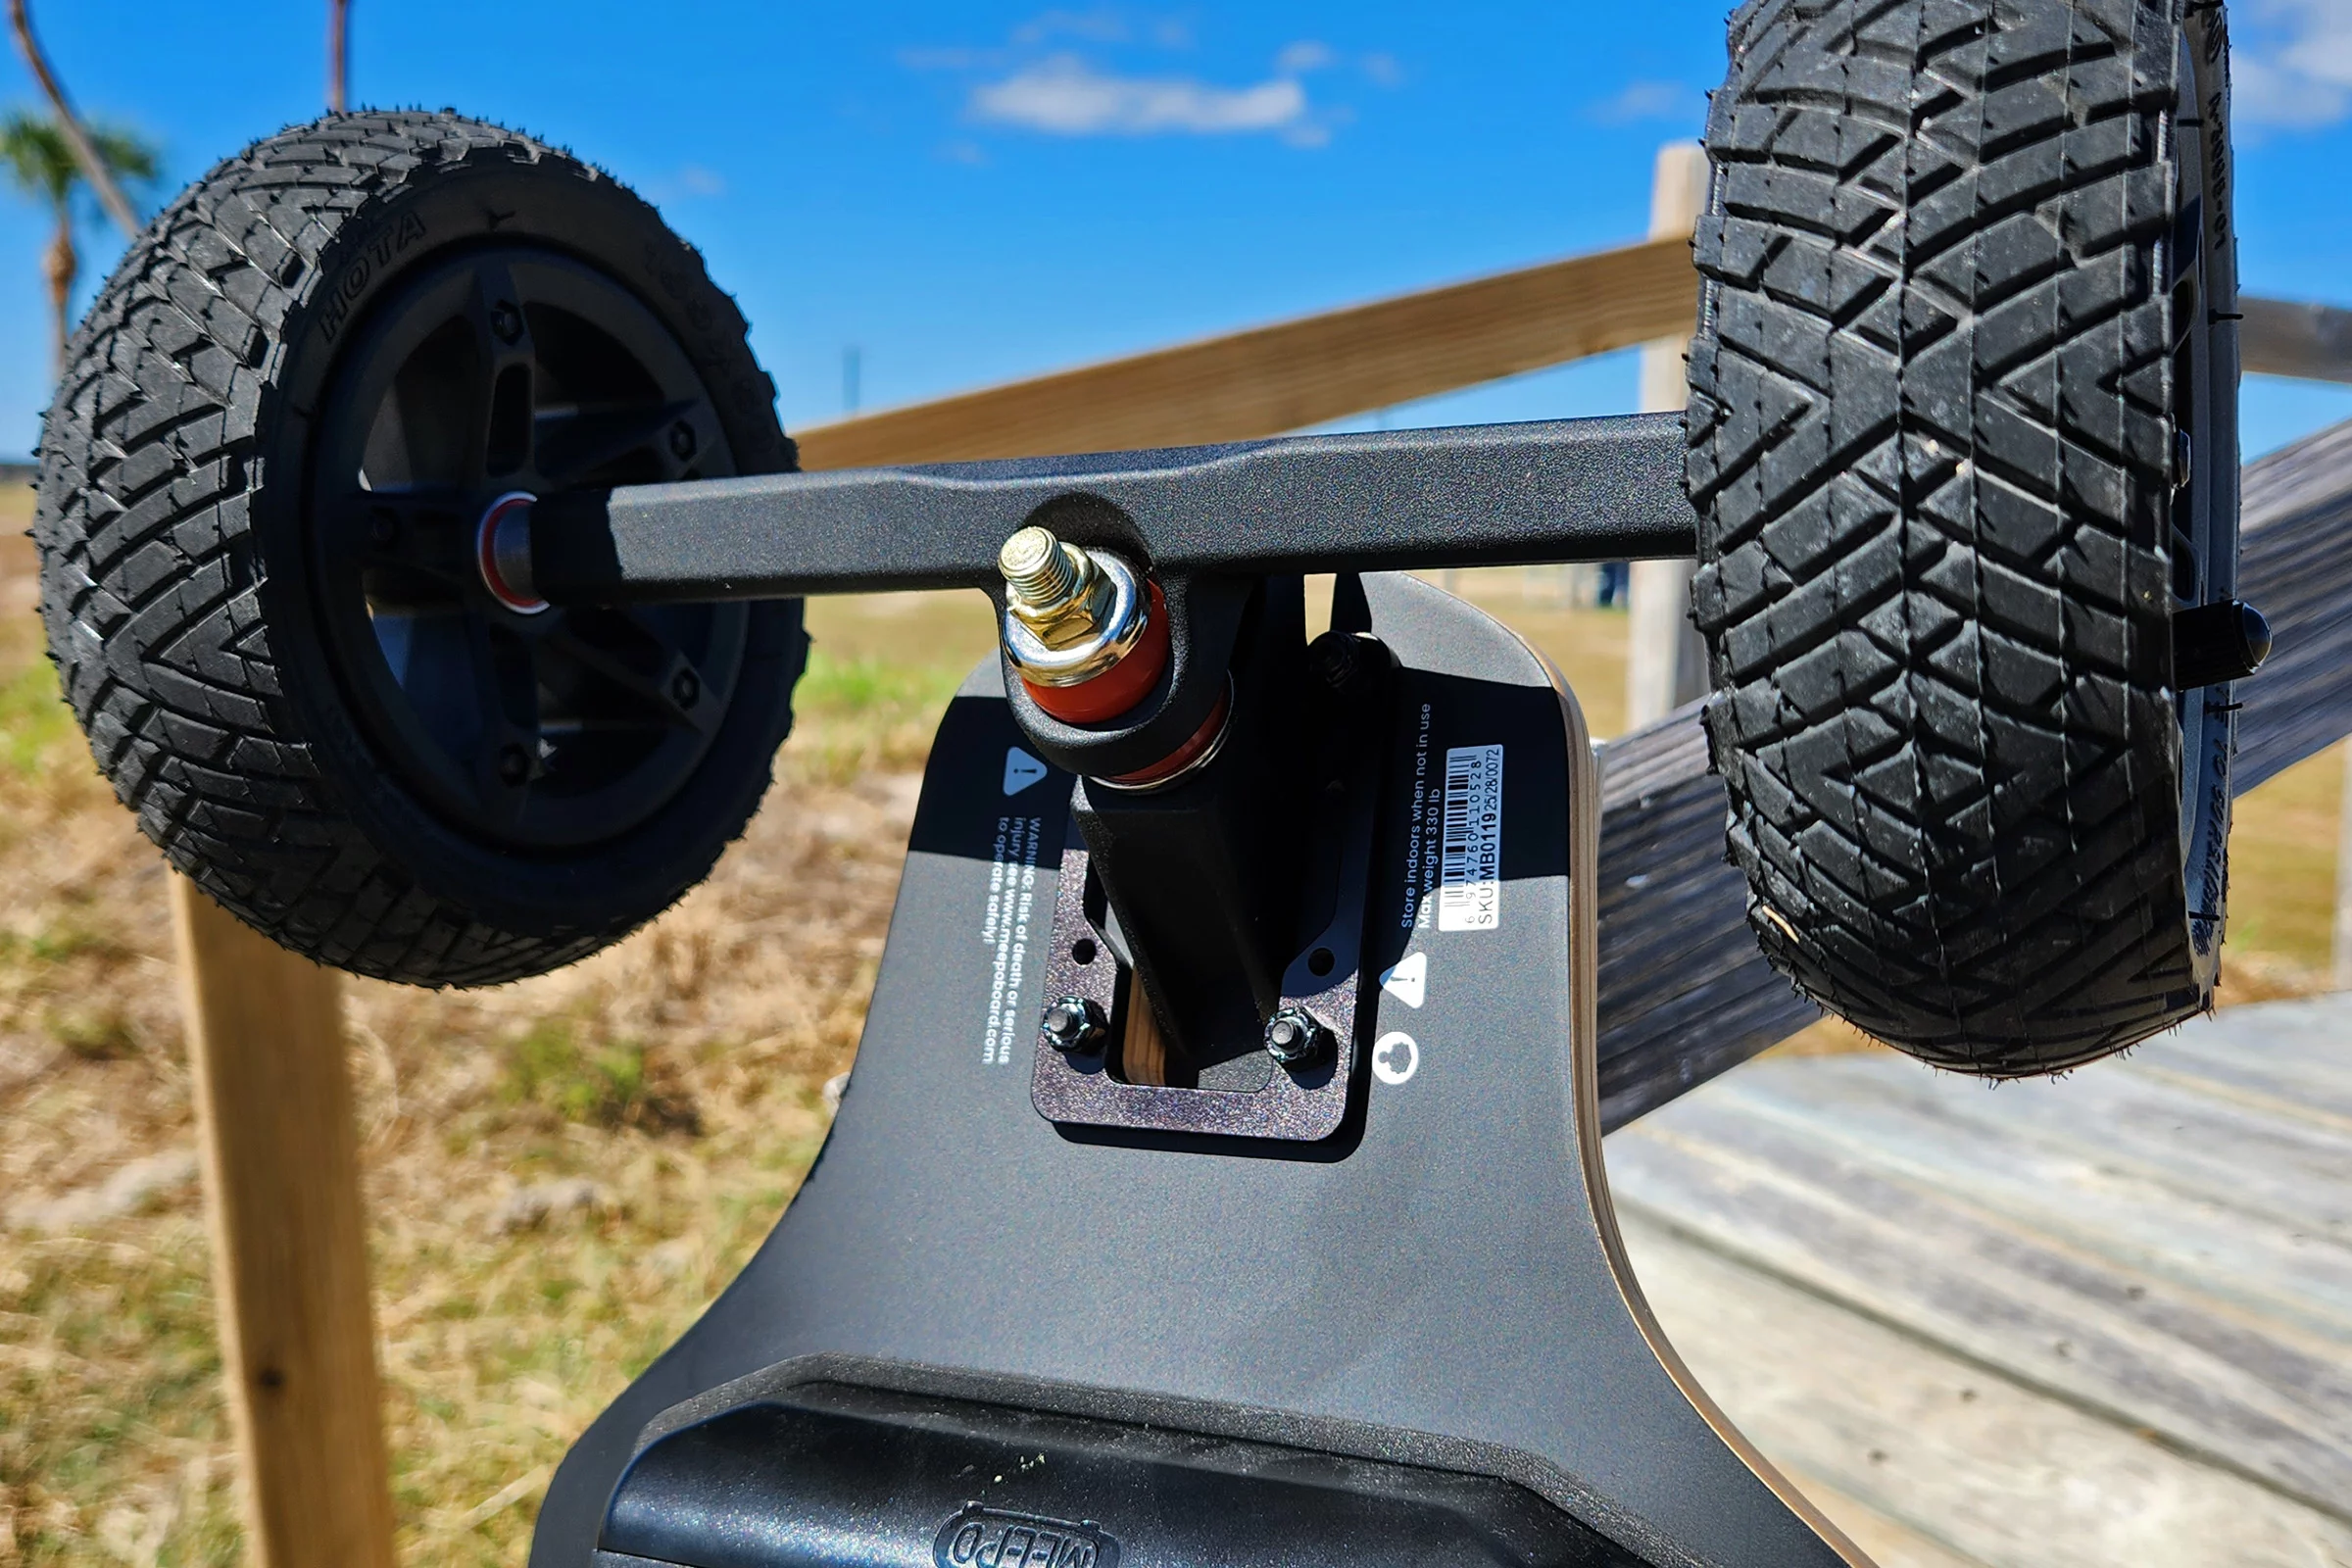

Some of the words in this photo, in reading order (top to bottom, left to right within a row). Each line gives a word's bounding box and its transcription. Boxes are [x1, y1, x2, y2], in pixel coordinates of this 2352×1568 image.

[318, 211, 427, 342] HOTA
[1421, 703, 1431, 730] use
[1415, 734, 1428, 748] in
[1416, 751, 1428, 776] not
[1412, 780, 1425, 822] when
[1429, 788, 1441, 803] lb
[998, 816, 1010, 832] to
[1007, 817, 1026, 858] injury
[1426, 808, 1440, 836] 330
[989, 834, 1006, 894] operate
[1021, 817, 1041, 890] WARNING:
[1404, 825, 1421, 884] indoors
[1422, 838, 1439, 894] weight
[1006, 861, 1018, 888] see
[981, 895, 1000, 946] safely!
[1016, 892, 1033, 924] Risk
[1401, 888, 1416, 929] Store
[1418, 895, 1433, 929] Max
[1014, 925, 1028, 941] of
[981, 888, 1015, 1065] www.meepoboard.com
[1008, 943, 1026, 989] death
[1006, 990, 1018, 1007] or
[998, 1008, 1015, 1065] serious
[952, 1522, 1098, 1568] MEEPO
